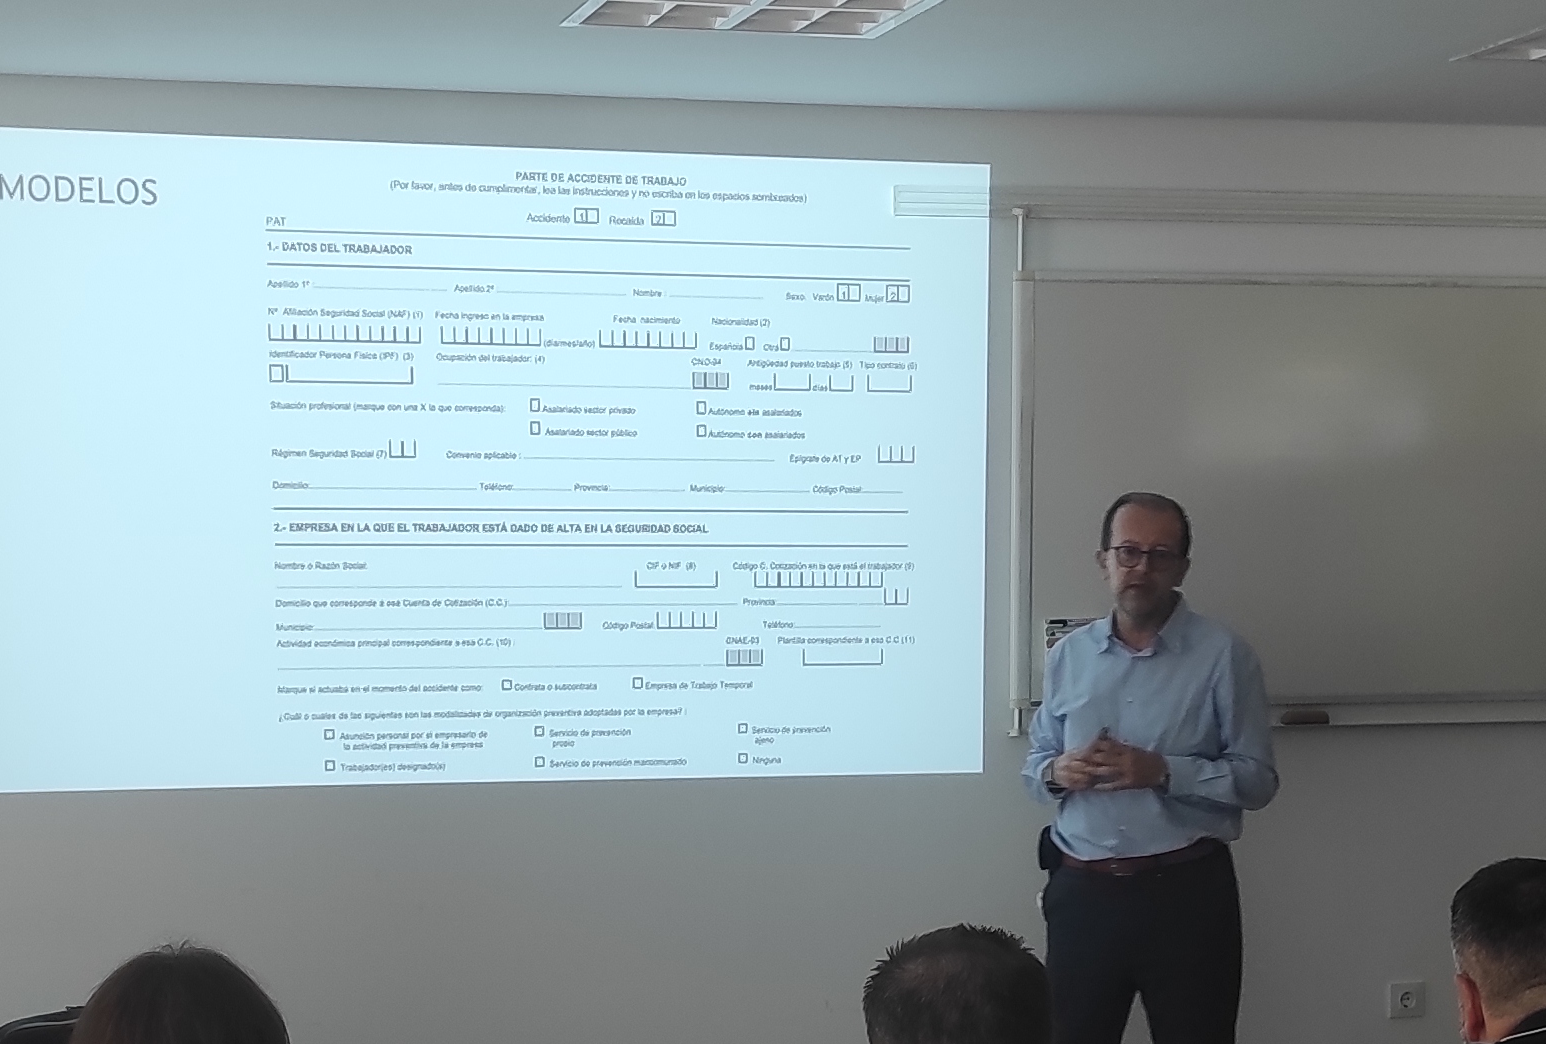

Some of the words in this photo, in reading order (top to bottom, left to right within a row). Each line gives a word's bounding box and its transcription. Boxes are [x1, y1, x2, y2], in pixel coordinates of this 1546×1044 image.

[516, 172, 548, 182] PARTE
[551, 173, 565, 182] DE
[567, 173, 622, 184] ACCIDENTE
[625, 175, 638, 185] DE
[641, 176, 686, 186] TRABAJO
[465, 184, 477, 192] de
[266, 217, 286, 226] PAT
[526, 213, 570, 223] Accidente
[282, 242, 317, 252] DATOS
[320, 243, 341, 253] DEL
[342, 244, 412, 255] TRABAJADOR
[289, 523, 338, 532] EMPRESA
[341, 523, 354, 532] EN
[357, 523, 371, 532] LA
[373, 523, 395, 532] QUE
[397, 523, 410, 532] EL
[412, 523, 481, 533] TRABAJADOR
[482, 521, 508, 533] ESTÁ
[510, 523, 538, 533] DADO
[541, 524, 554, 533] DE
[556, 524, 582, 533] ALTA
[584, 524, 598, 533] EN
[601, 524, 613, 533] LA
[615, 524, 671, 533] SEGURIDAD
[673, 524, 709, 533] SOCIAL
